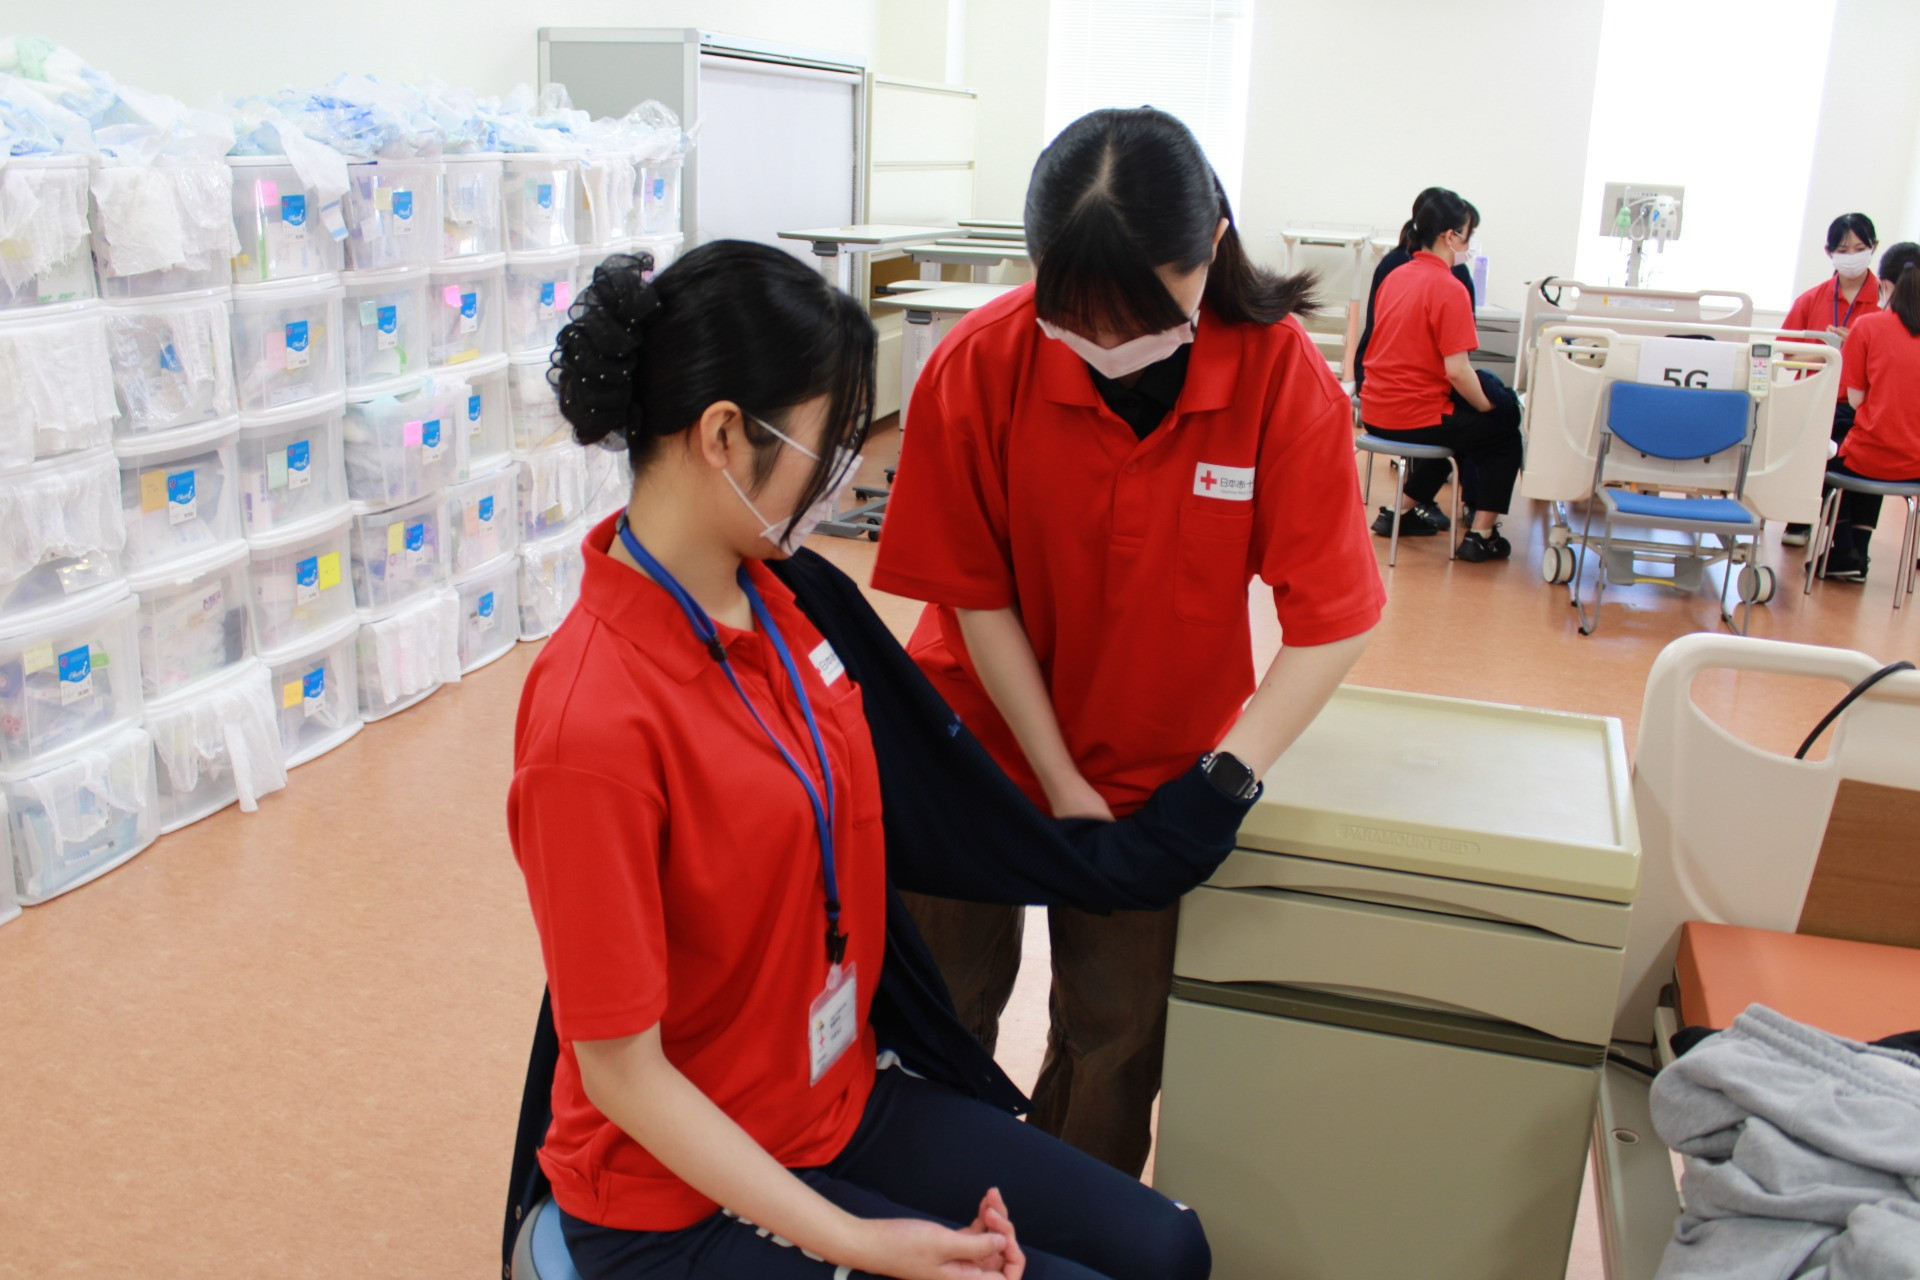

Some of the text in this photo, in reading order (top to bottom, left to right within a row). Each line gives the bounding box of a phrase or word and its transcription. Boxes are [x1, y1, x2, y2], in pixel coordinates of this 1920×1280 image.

[1663, 368, 1709, 389] 5G
[1344, 826, 1469, 856] PARAMOUNT BED
